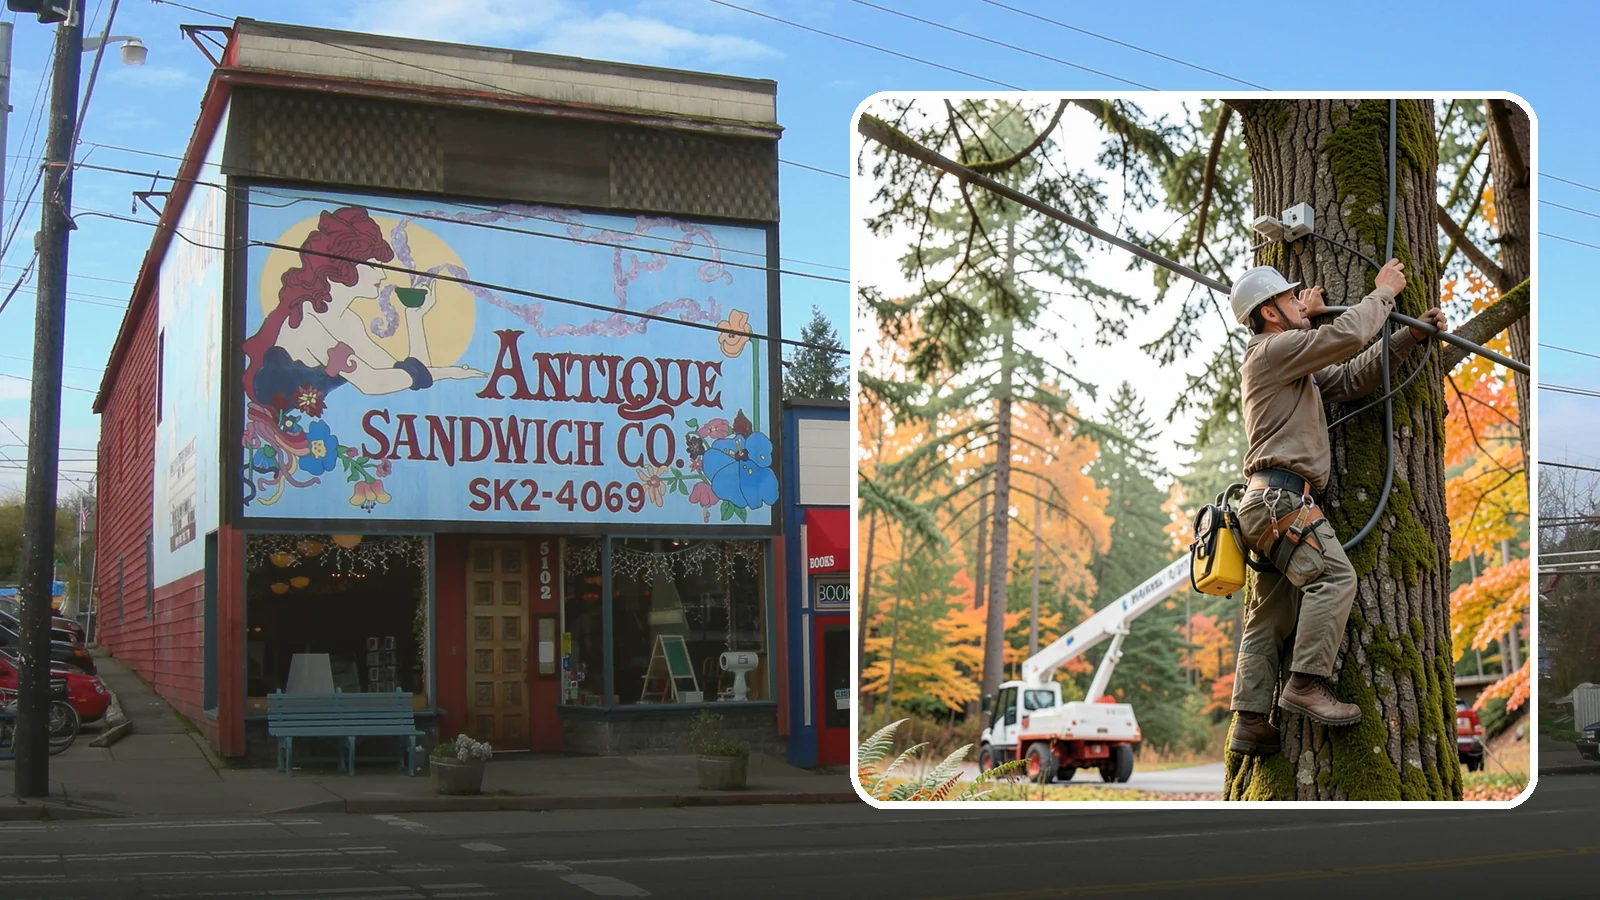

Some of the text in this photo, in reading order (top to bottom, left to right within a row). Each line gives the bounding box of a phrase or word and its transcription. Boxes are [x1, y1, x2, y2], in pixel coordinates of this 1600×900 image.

[475, 329, 724, 421] ANTIQUE
[361, 408, 685, 469] SANDWICH CO.
[468, 477, 646, 513] SK2-4069
[540, 541, 551, 600] 5102
[809, 555, 835, 569] BOOKS
